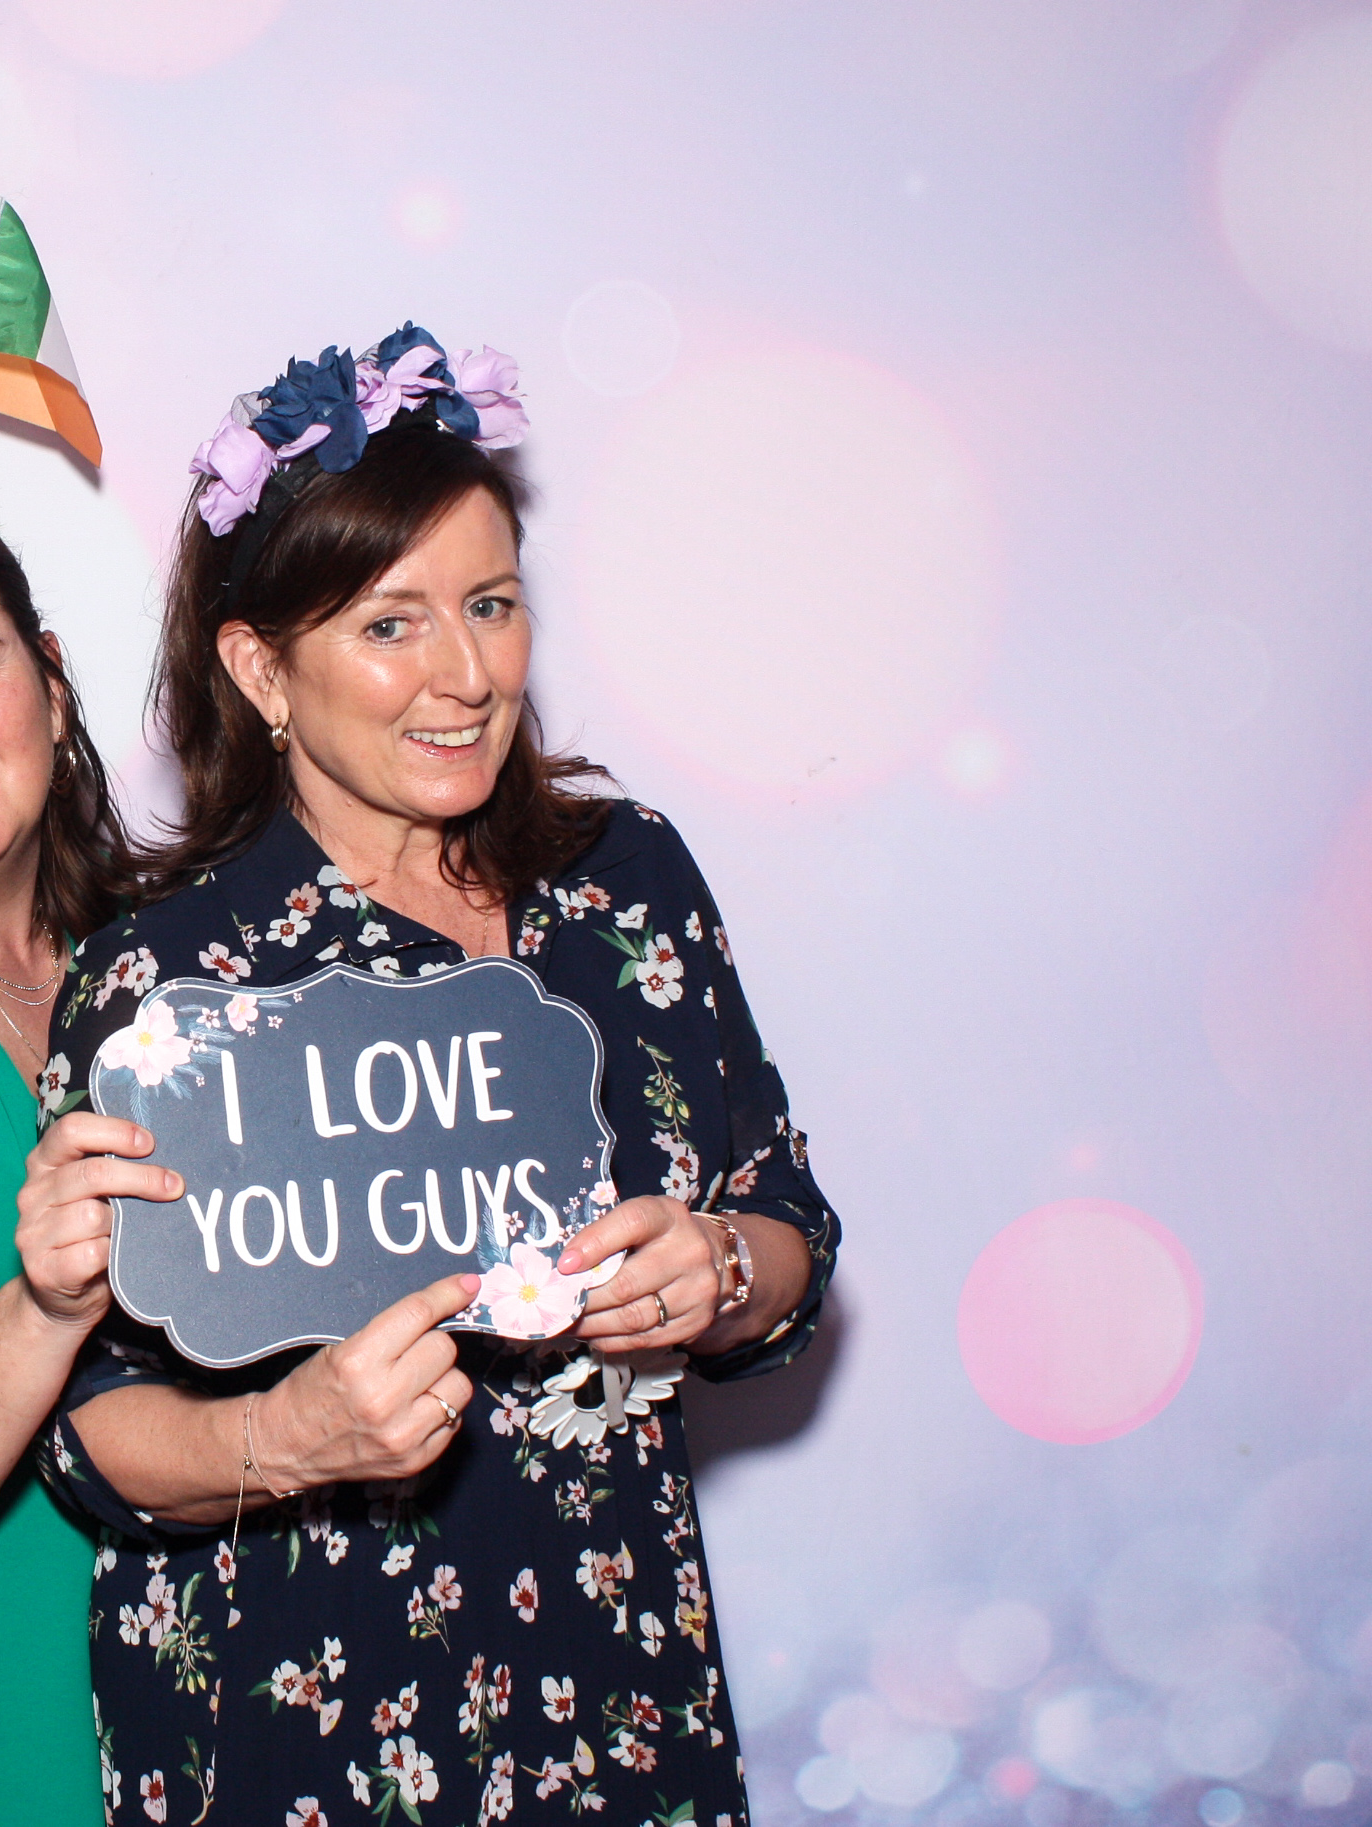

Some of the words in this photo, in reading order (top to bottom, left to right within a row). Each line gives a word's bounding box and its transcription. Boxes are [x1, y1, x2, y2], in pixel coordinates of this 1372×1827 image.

[220, 1049, 243, 1145] I
[305, 1031, 514, 1138] LOVE
[186, 1178, 339, 1273] YOU
[367, 1158, 560, 1255] GUYS
